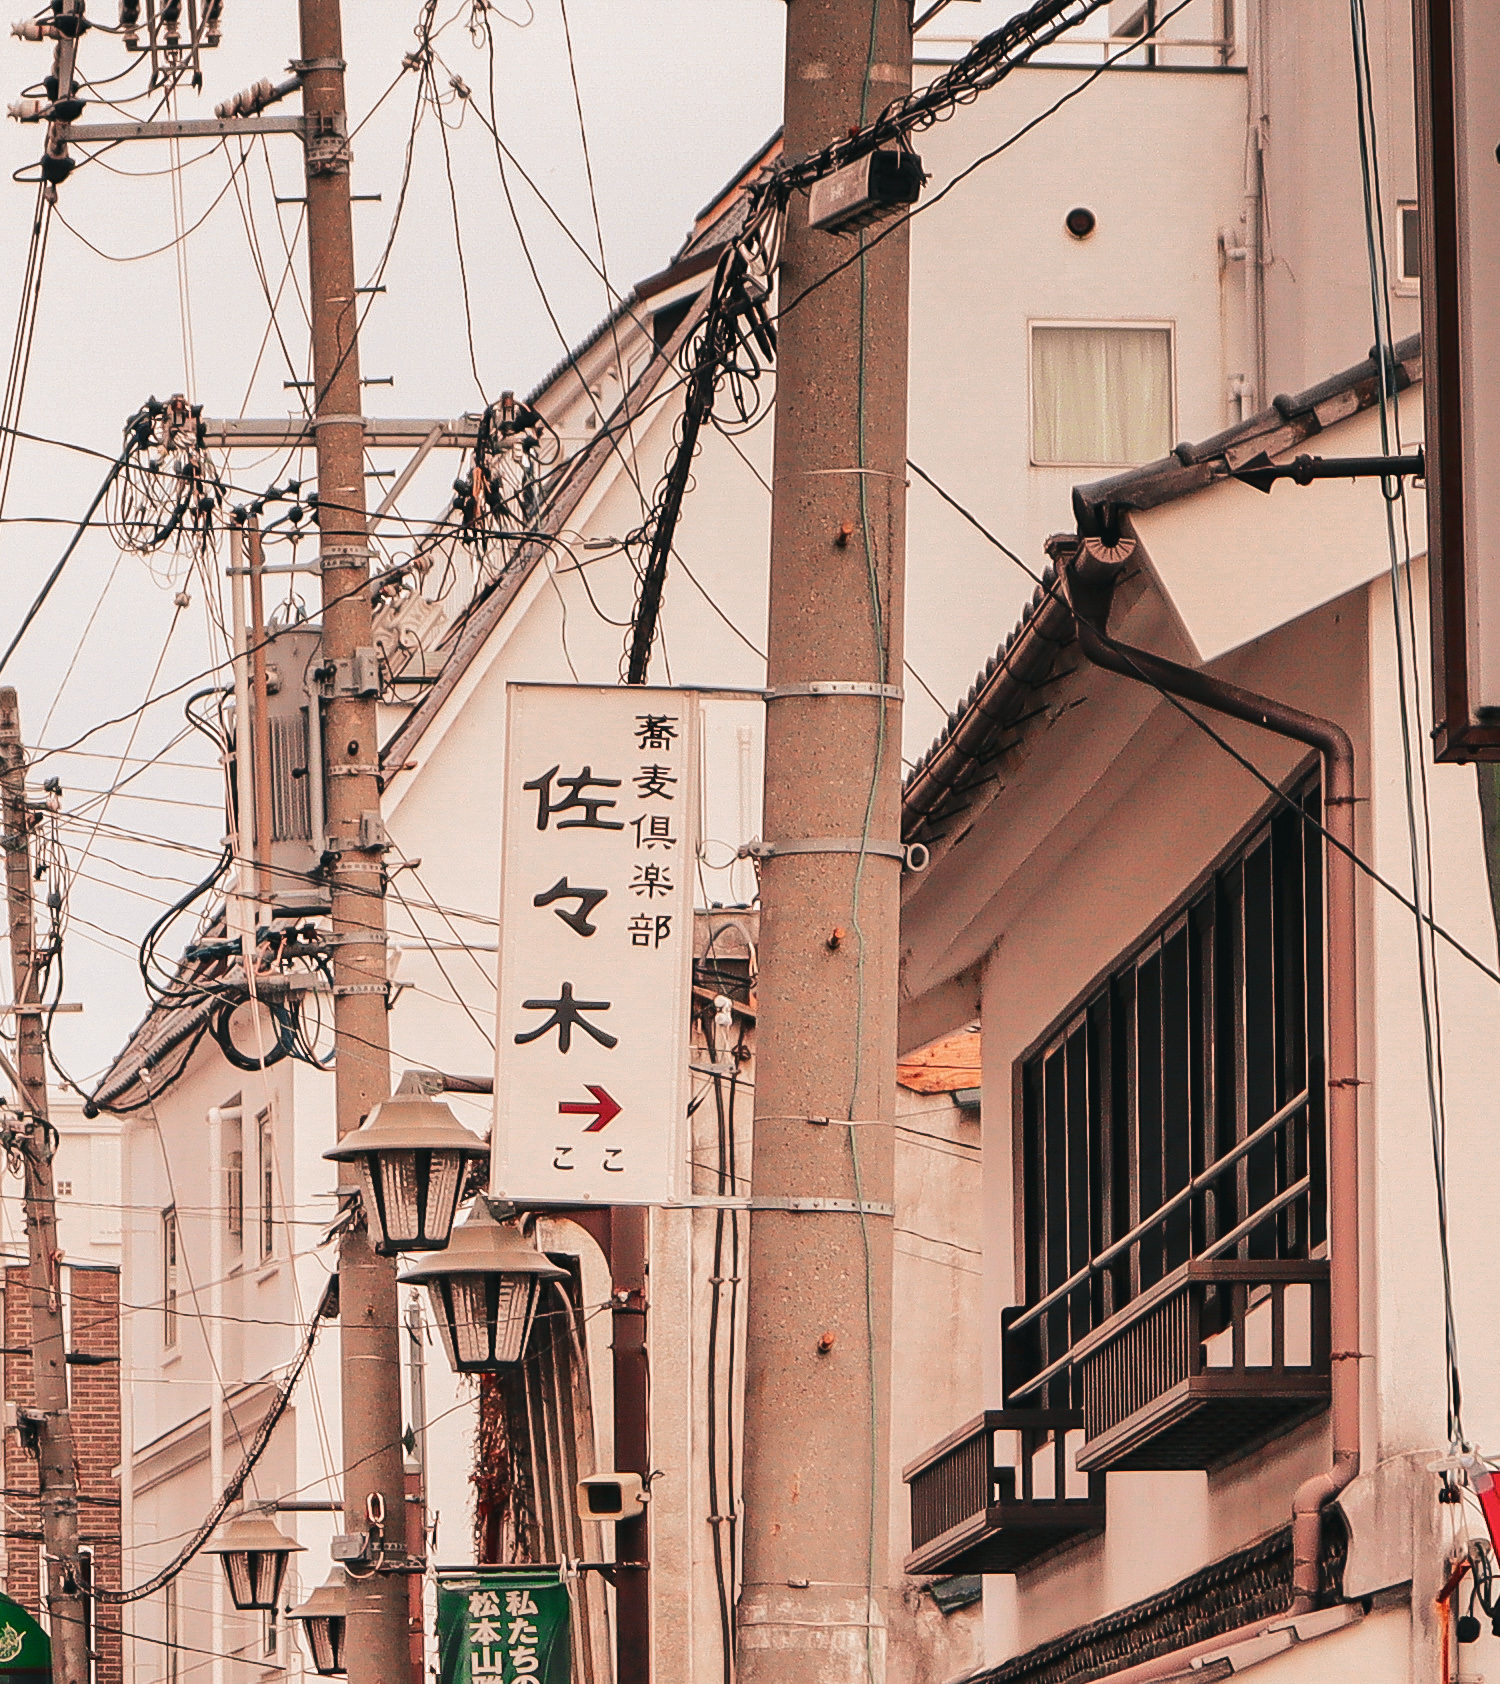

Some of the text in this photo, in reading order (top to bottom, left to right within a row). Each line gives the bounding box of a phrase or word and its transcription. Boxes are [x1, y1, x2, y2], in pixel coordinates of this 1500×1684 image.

[514, 763, 625, 1055] 佐々木
[627, 712, 681, 949] 蕎麦倶楽部
[551, 1146, 625, 1173] ここ
